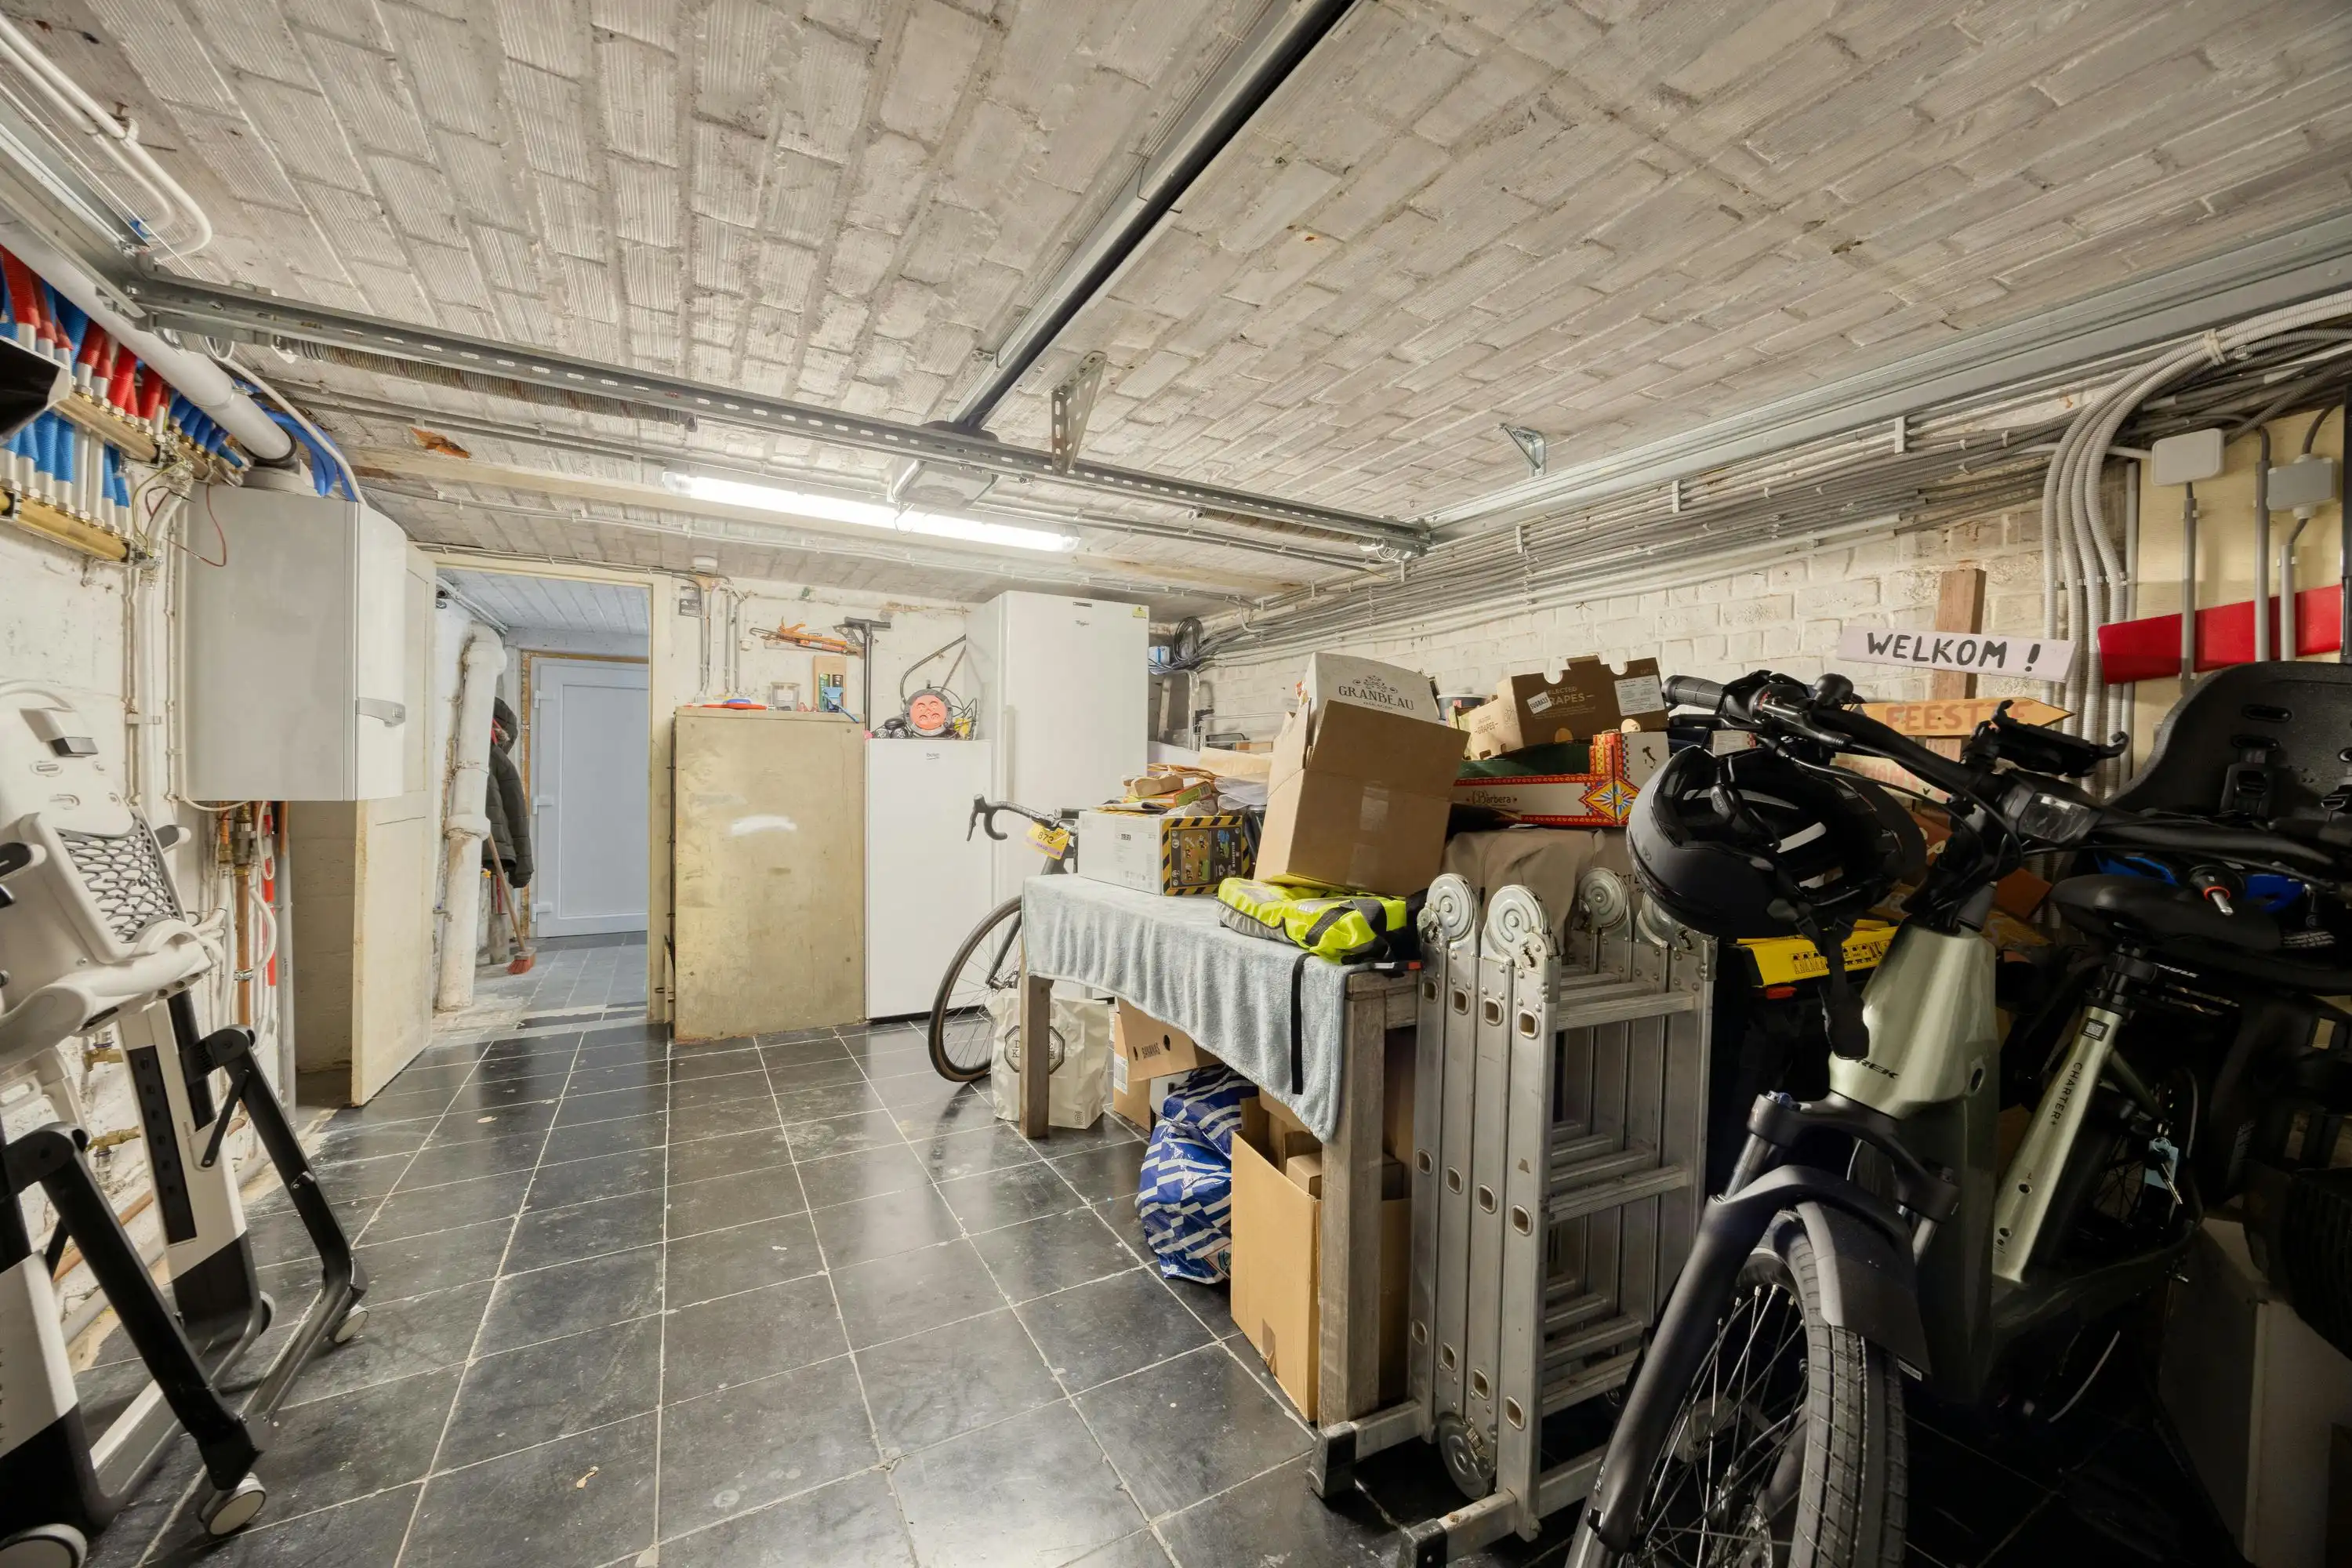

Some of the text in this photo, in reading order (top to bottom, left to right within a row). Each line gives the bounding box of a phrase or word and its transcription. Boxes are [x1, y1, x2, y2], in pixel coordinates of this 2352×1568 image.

[1867, 632, 2042, 672] WELKOM !
[1338, 685, 1414, 710] GRANBEAU
[1546, 686, 1577, 695] ELECTED
[1549, 692, 1585, 706] RAPES
[1885, 700, 2034, 731] FEESTE
[1038, 831, 1054, 844] 873
[2051, 1062, 2083, 1127] CHARTER+
